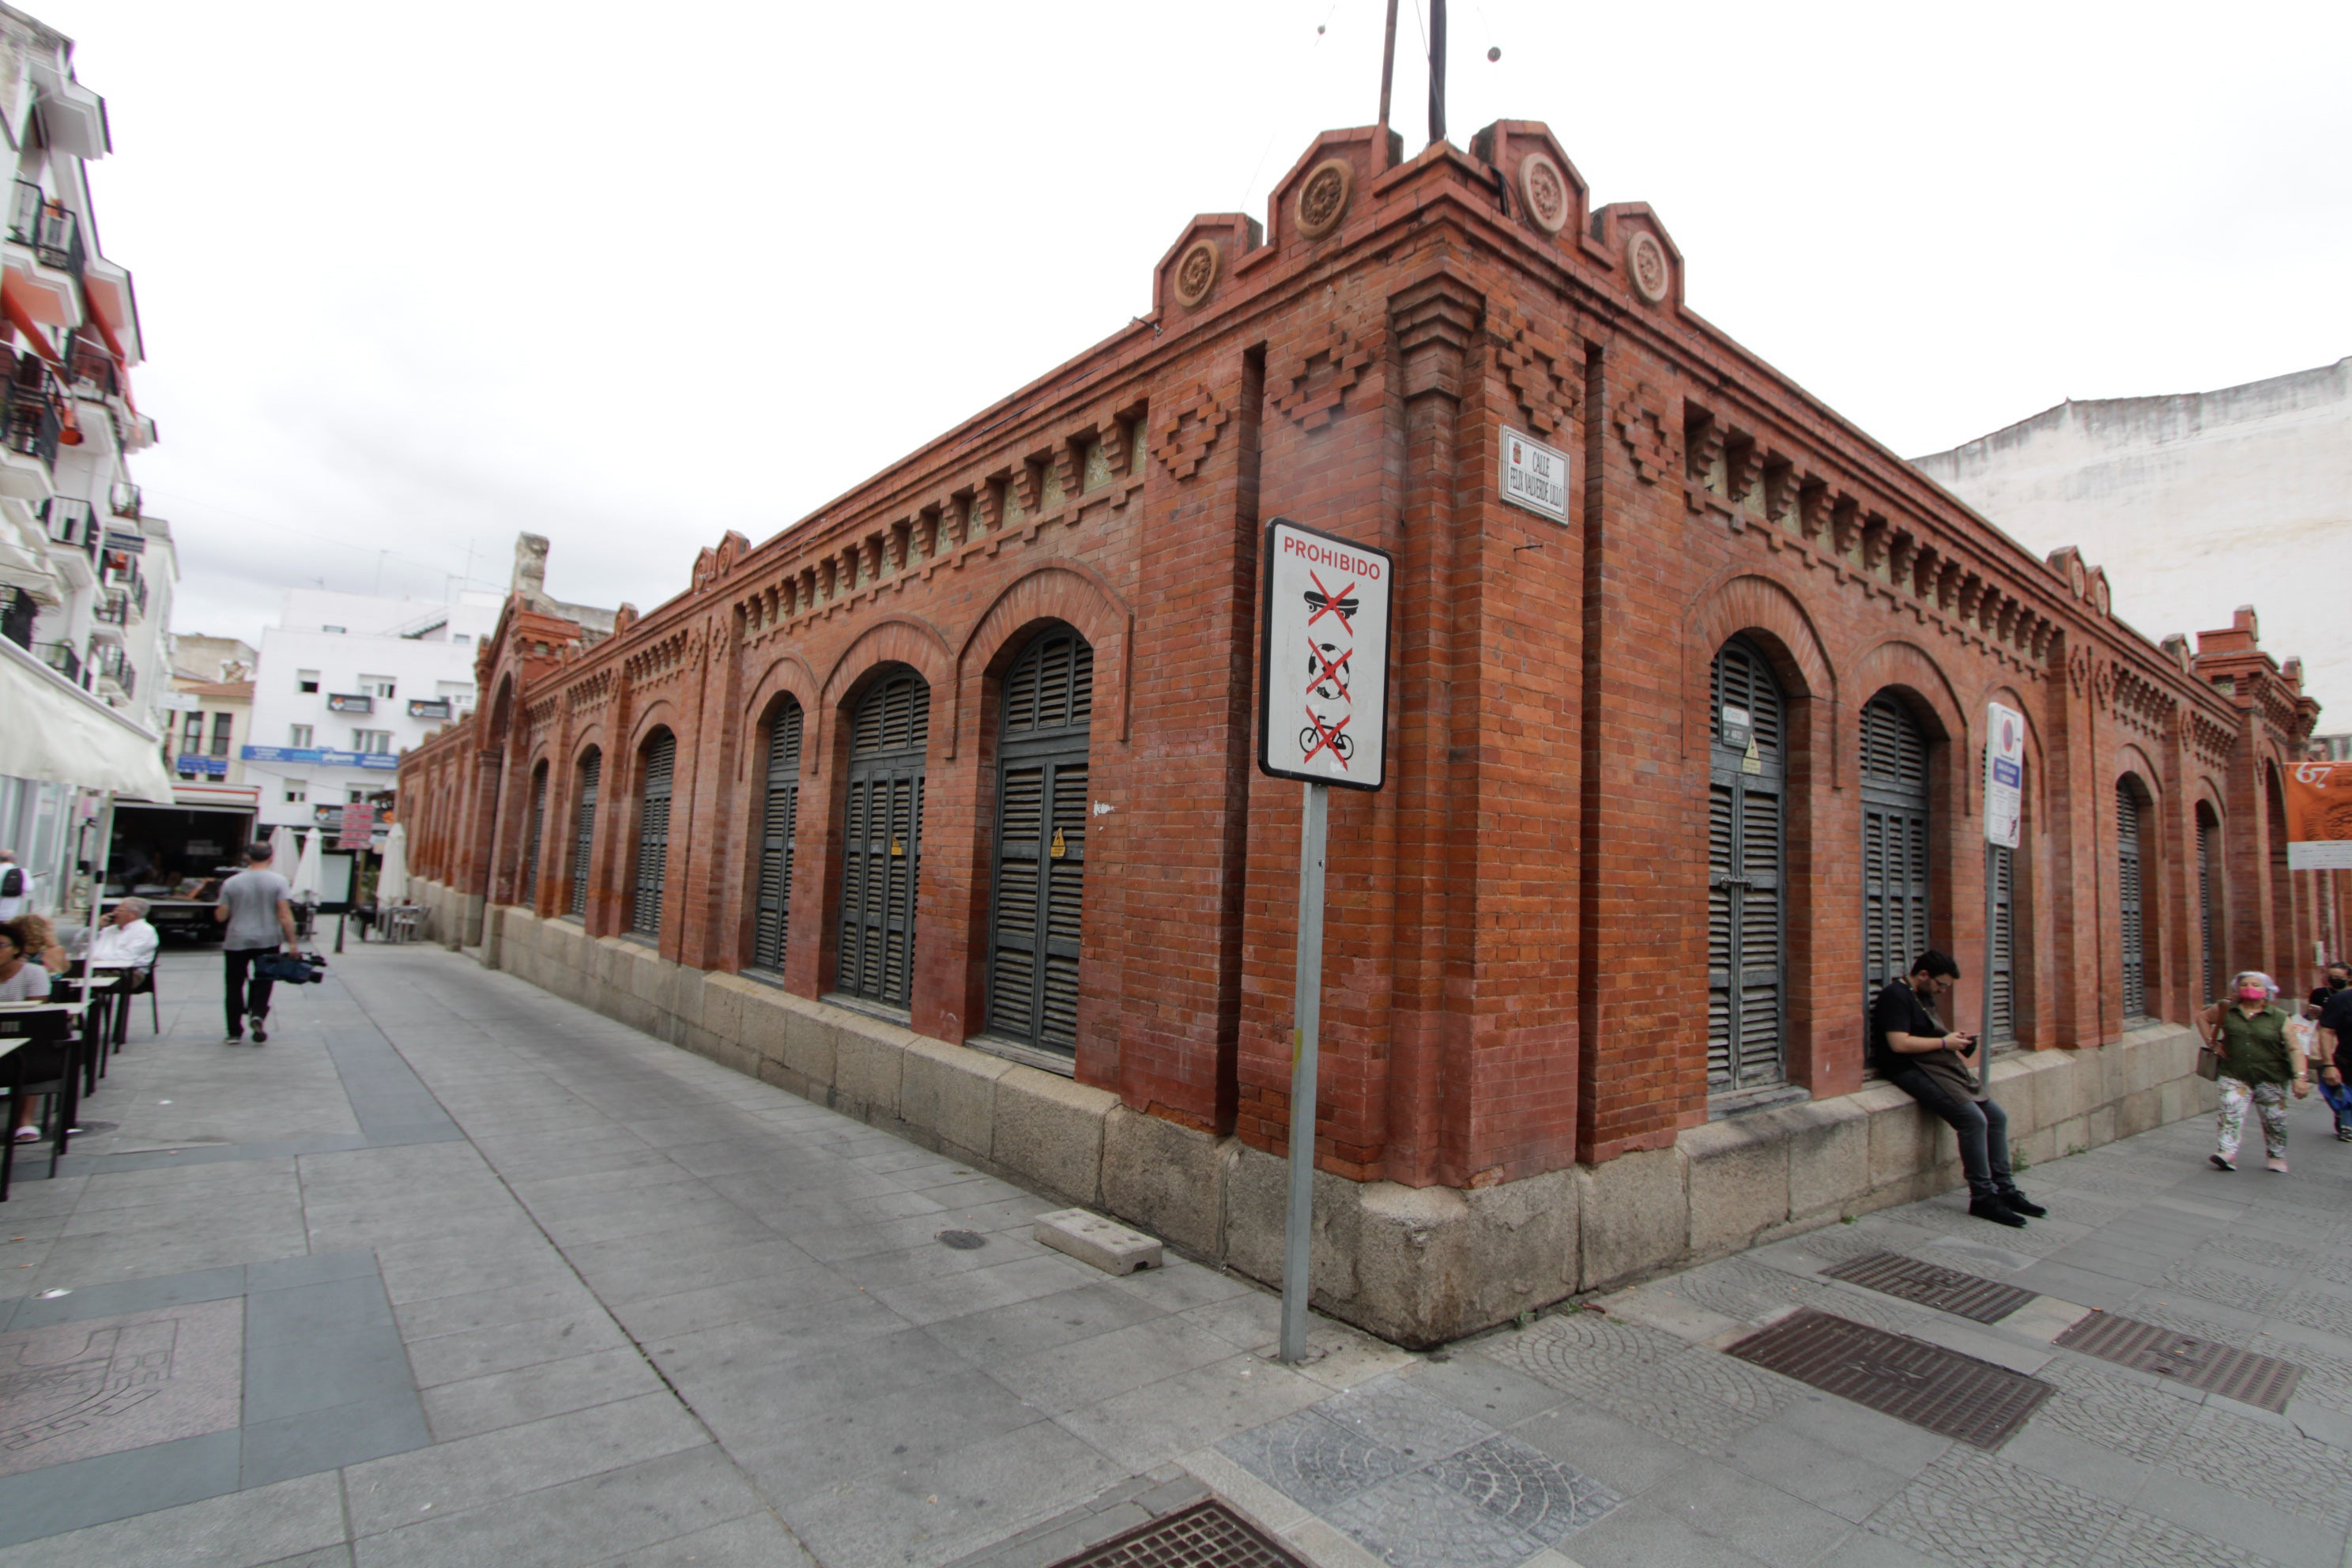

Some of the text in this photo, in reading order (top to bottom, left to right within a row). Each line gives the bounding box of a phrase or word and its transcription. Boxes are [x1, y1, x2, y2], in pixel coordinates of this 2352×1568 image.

[1533, 451, 1550, 477] CALLE
[1510, 467, 1524, 492] FELIX
[1525, 473, 1549, 502] VALVERDE
[1284, 536, 1381, 580] PROHIBIDO
